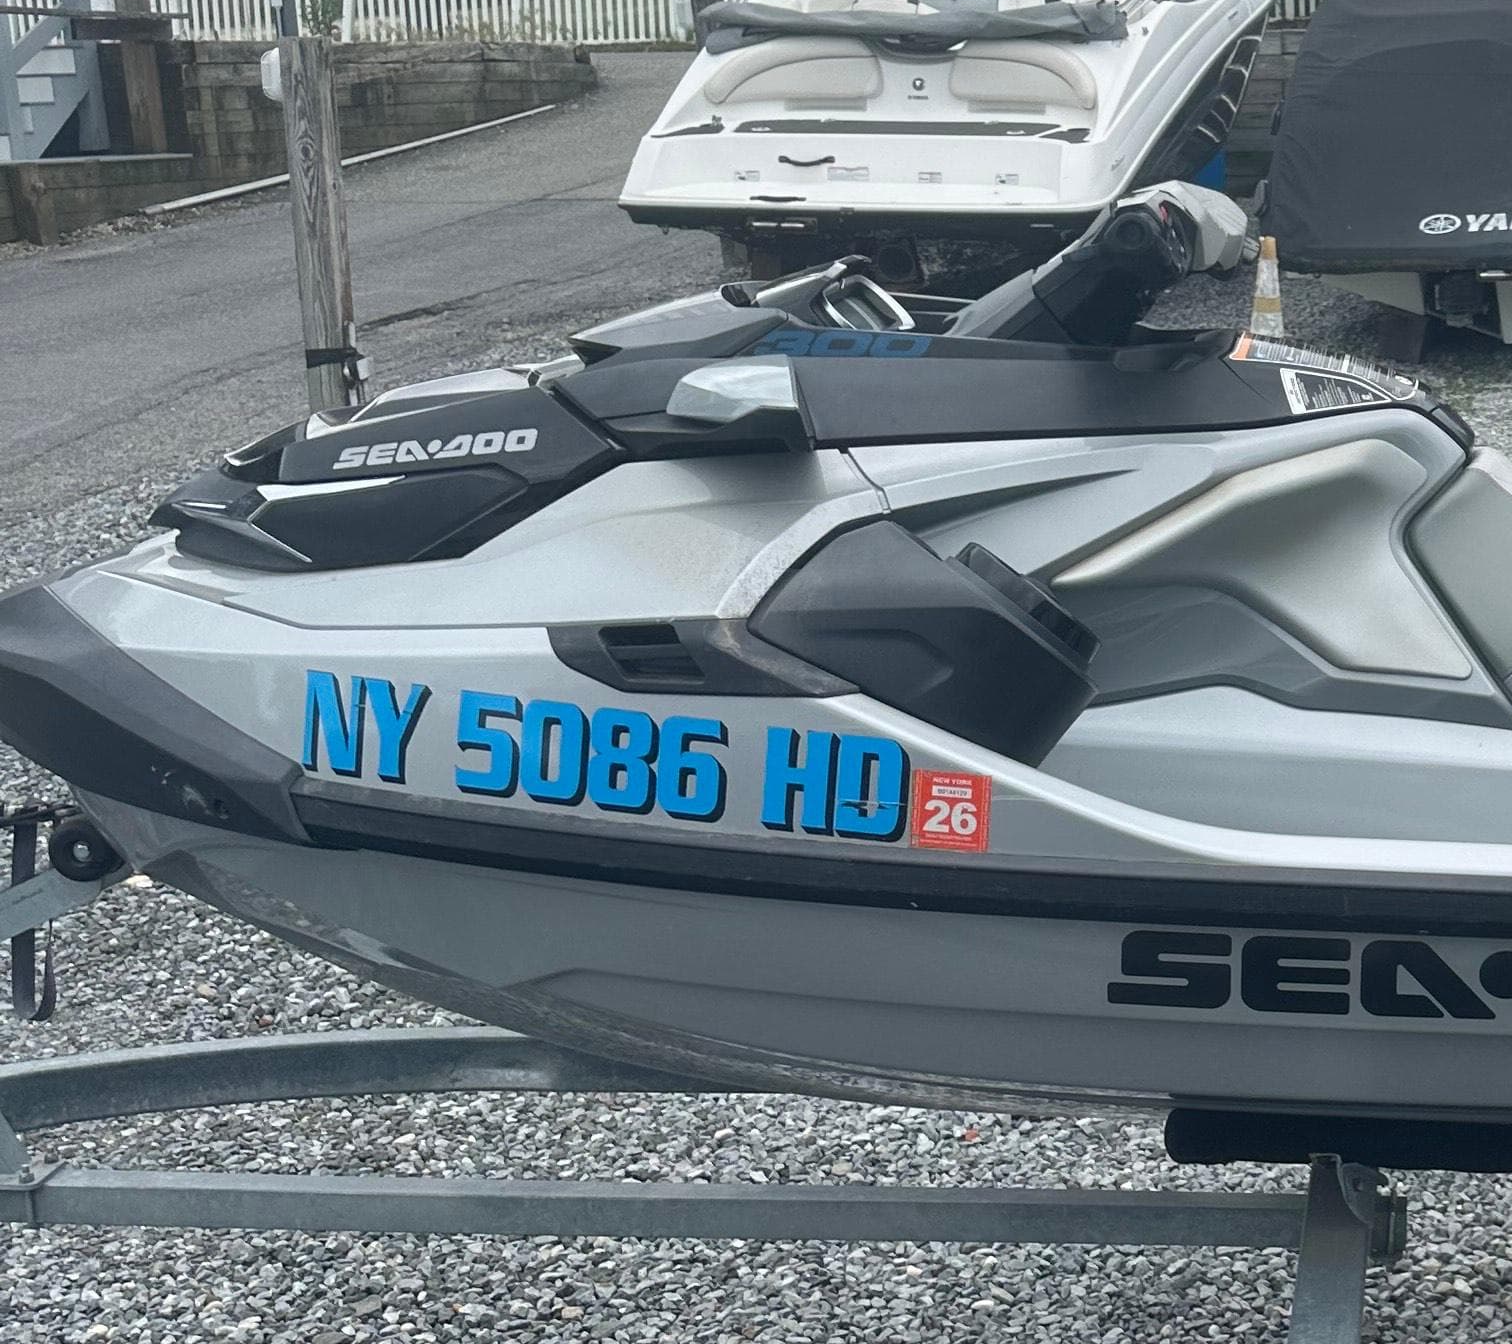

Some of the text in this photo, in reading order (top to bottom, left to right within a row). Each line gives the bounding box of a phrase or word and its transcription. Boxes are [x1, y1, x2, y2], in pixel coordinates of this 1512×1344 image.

[753, 330, 932, 359] 300
[302, 670, 911, 842] NY 5086 HD
[923, 799, 977, 835] 26
